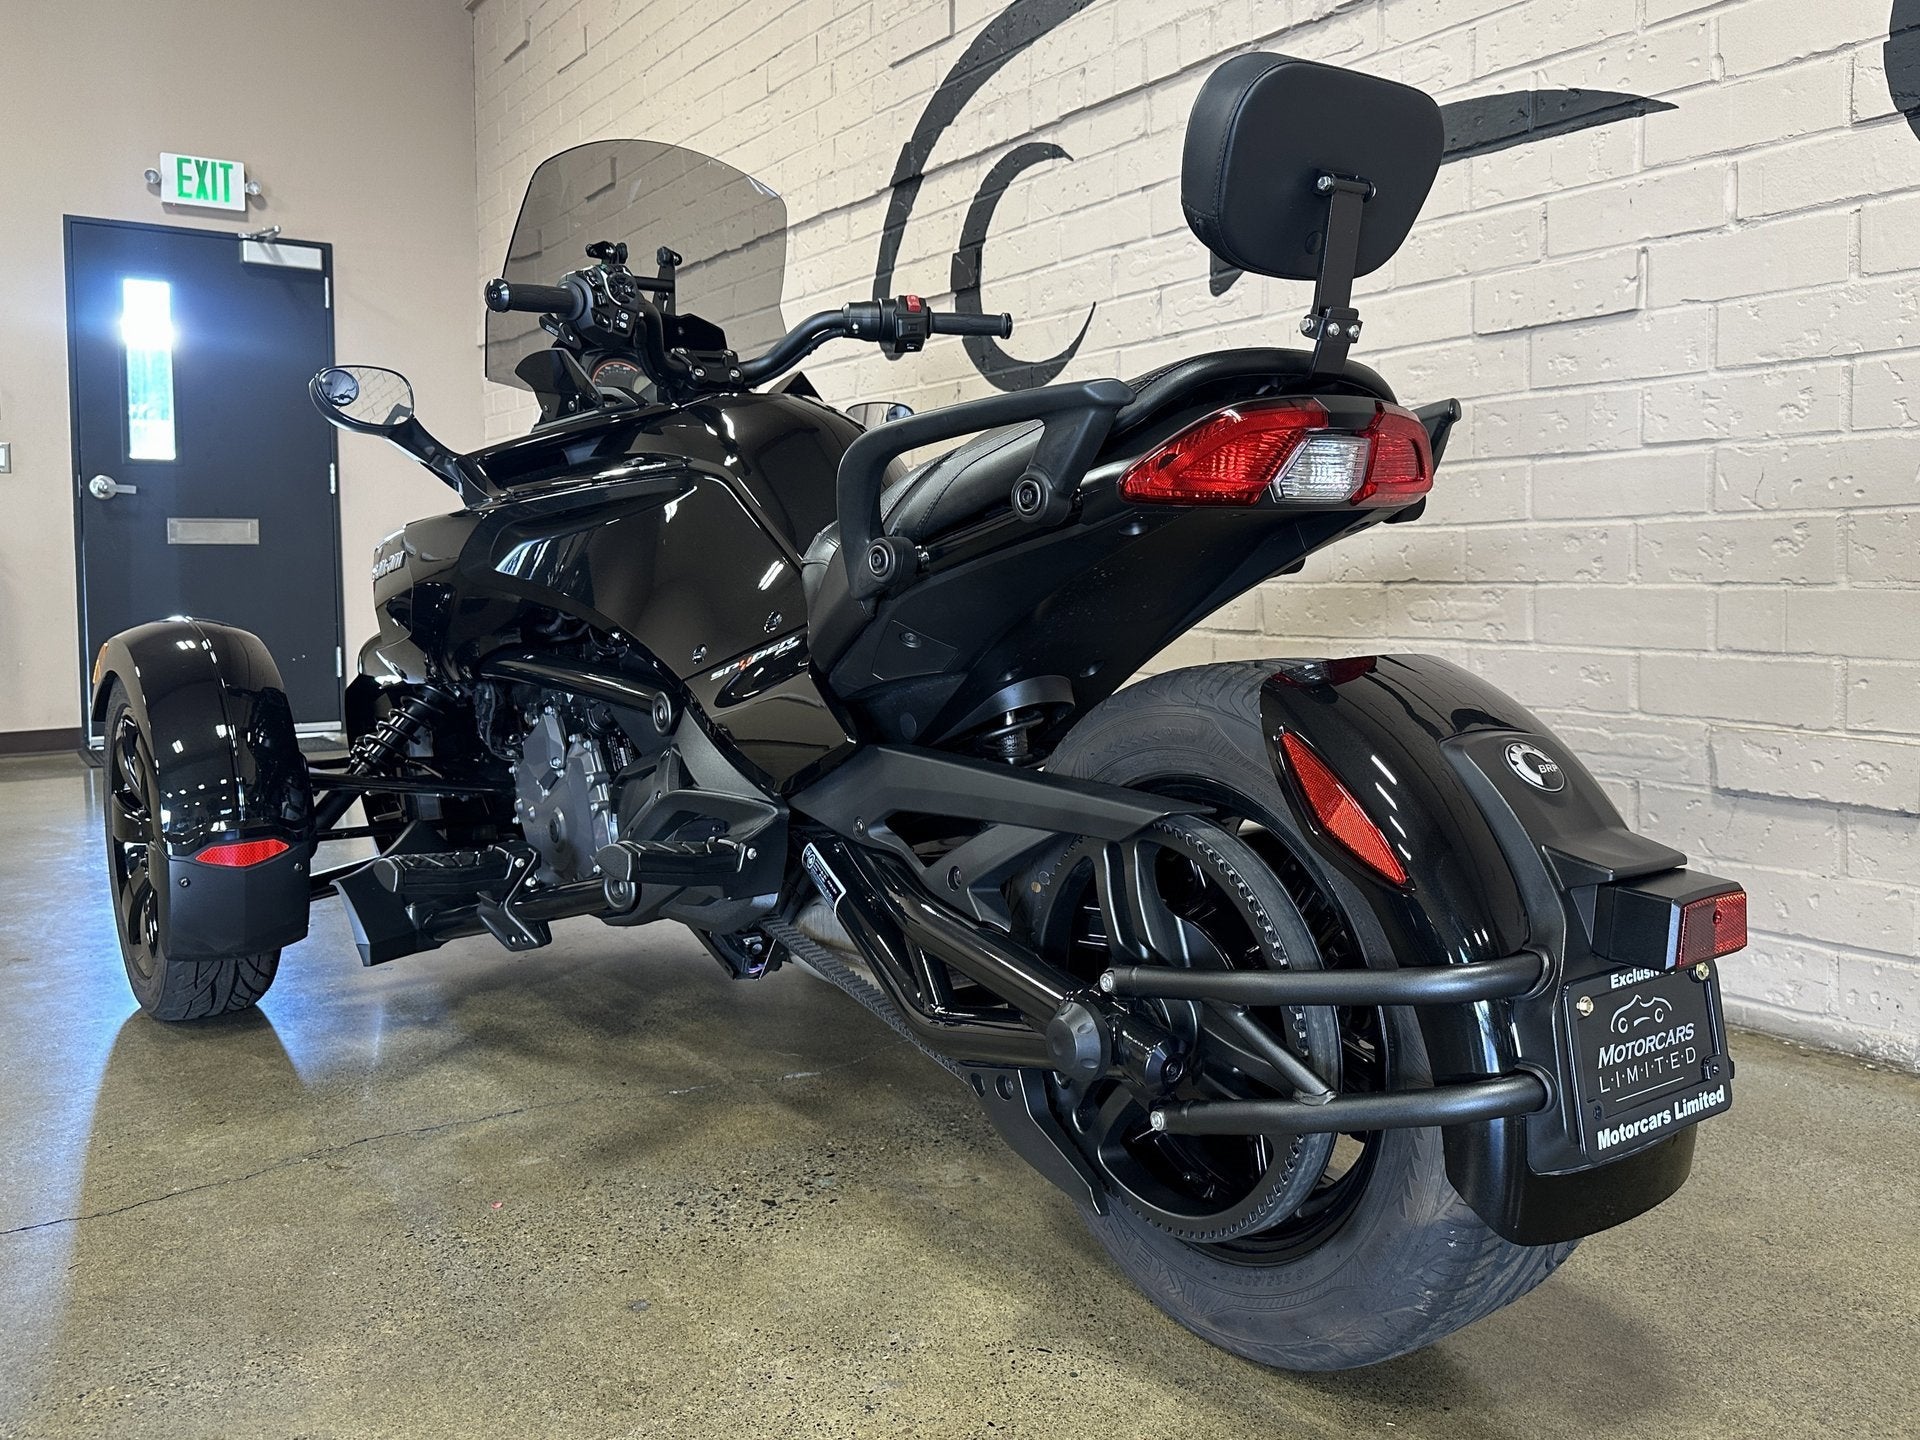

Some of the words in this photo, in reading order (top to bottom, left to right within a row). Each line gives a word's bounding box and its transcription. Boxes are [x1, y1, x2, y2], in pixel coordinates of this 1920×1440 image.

[176, 157, 233, 202] EXIT
[1537, 763, 1558, 774] BRP
[1598, 1022, 1695, 1069] MOTORCARS
[1596, 1109, 1671, 1150] Motorcars
[1673, 1084, 1725, 1120] Limited
